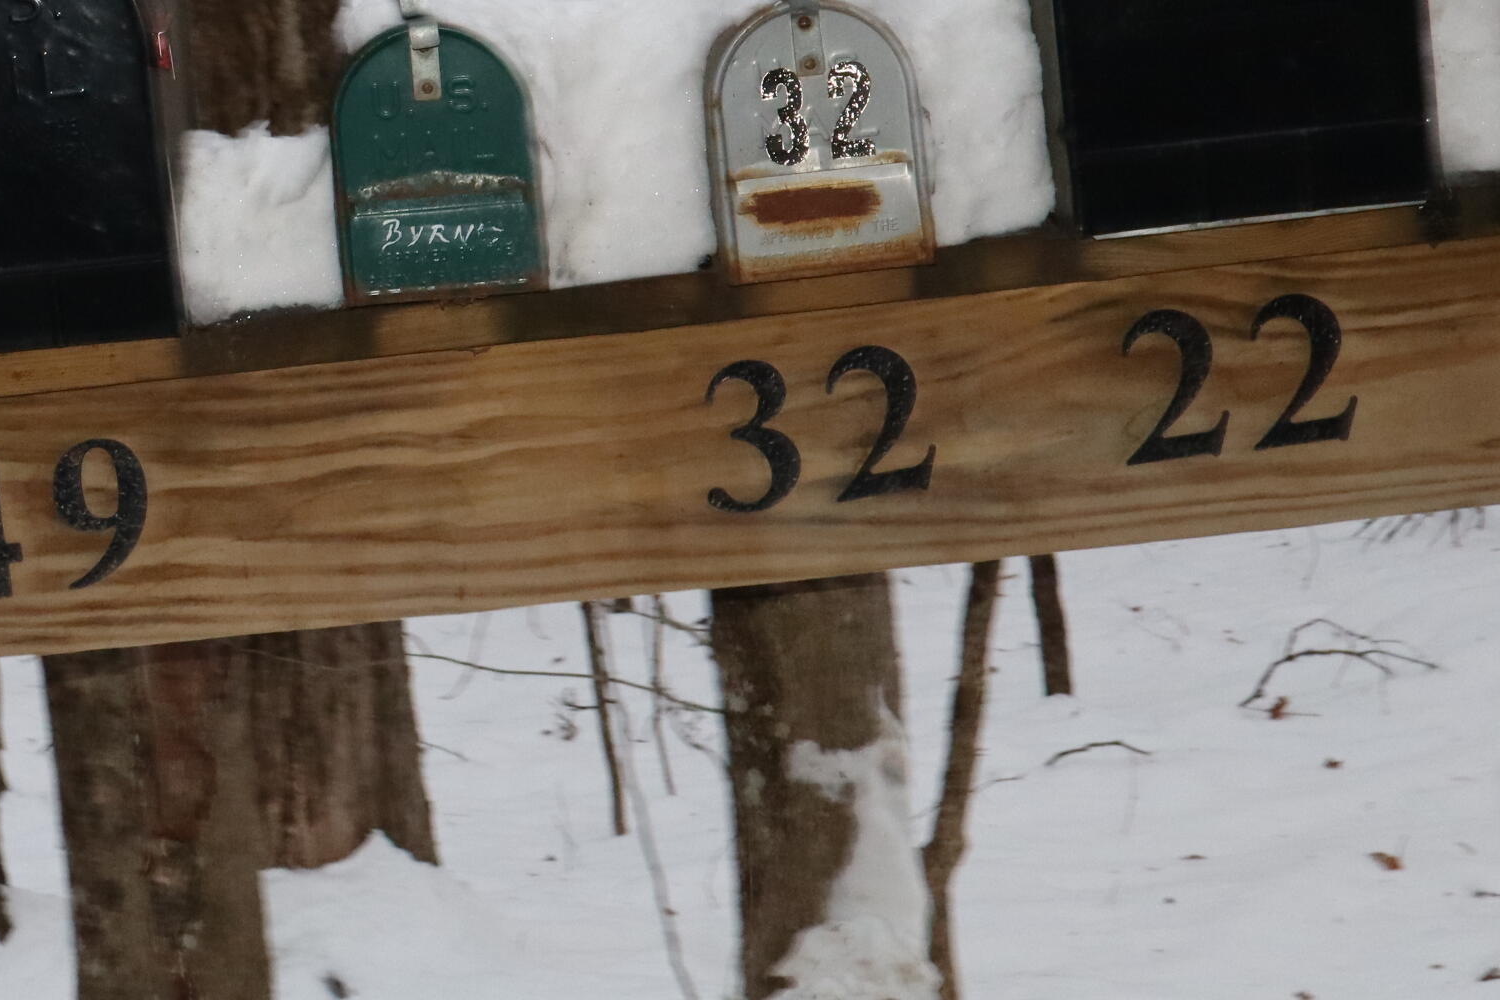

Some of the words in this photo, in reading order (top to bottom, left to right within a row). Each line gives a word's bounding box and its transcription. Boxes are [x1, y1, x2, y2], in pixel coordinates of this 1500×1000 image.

[760, 60, 877, 166] 32
[872, 217, 900, 234] THE
[705, 345, 936, 513] 32
[1122, 294, 1358, 466] 22
